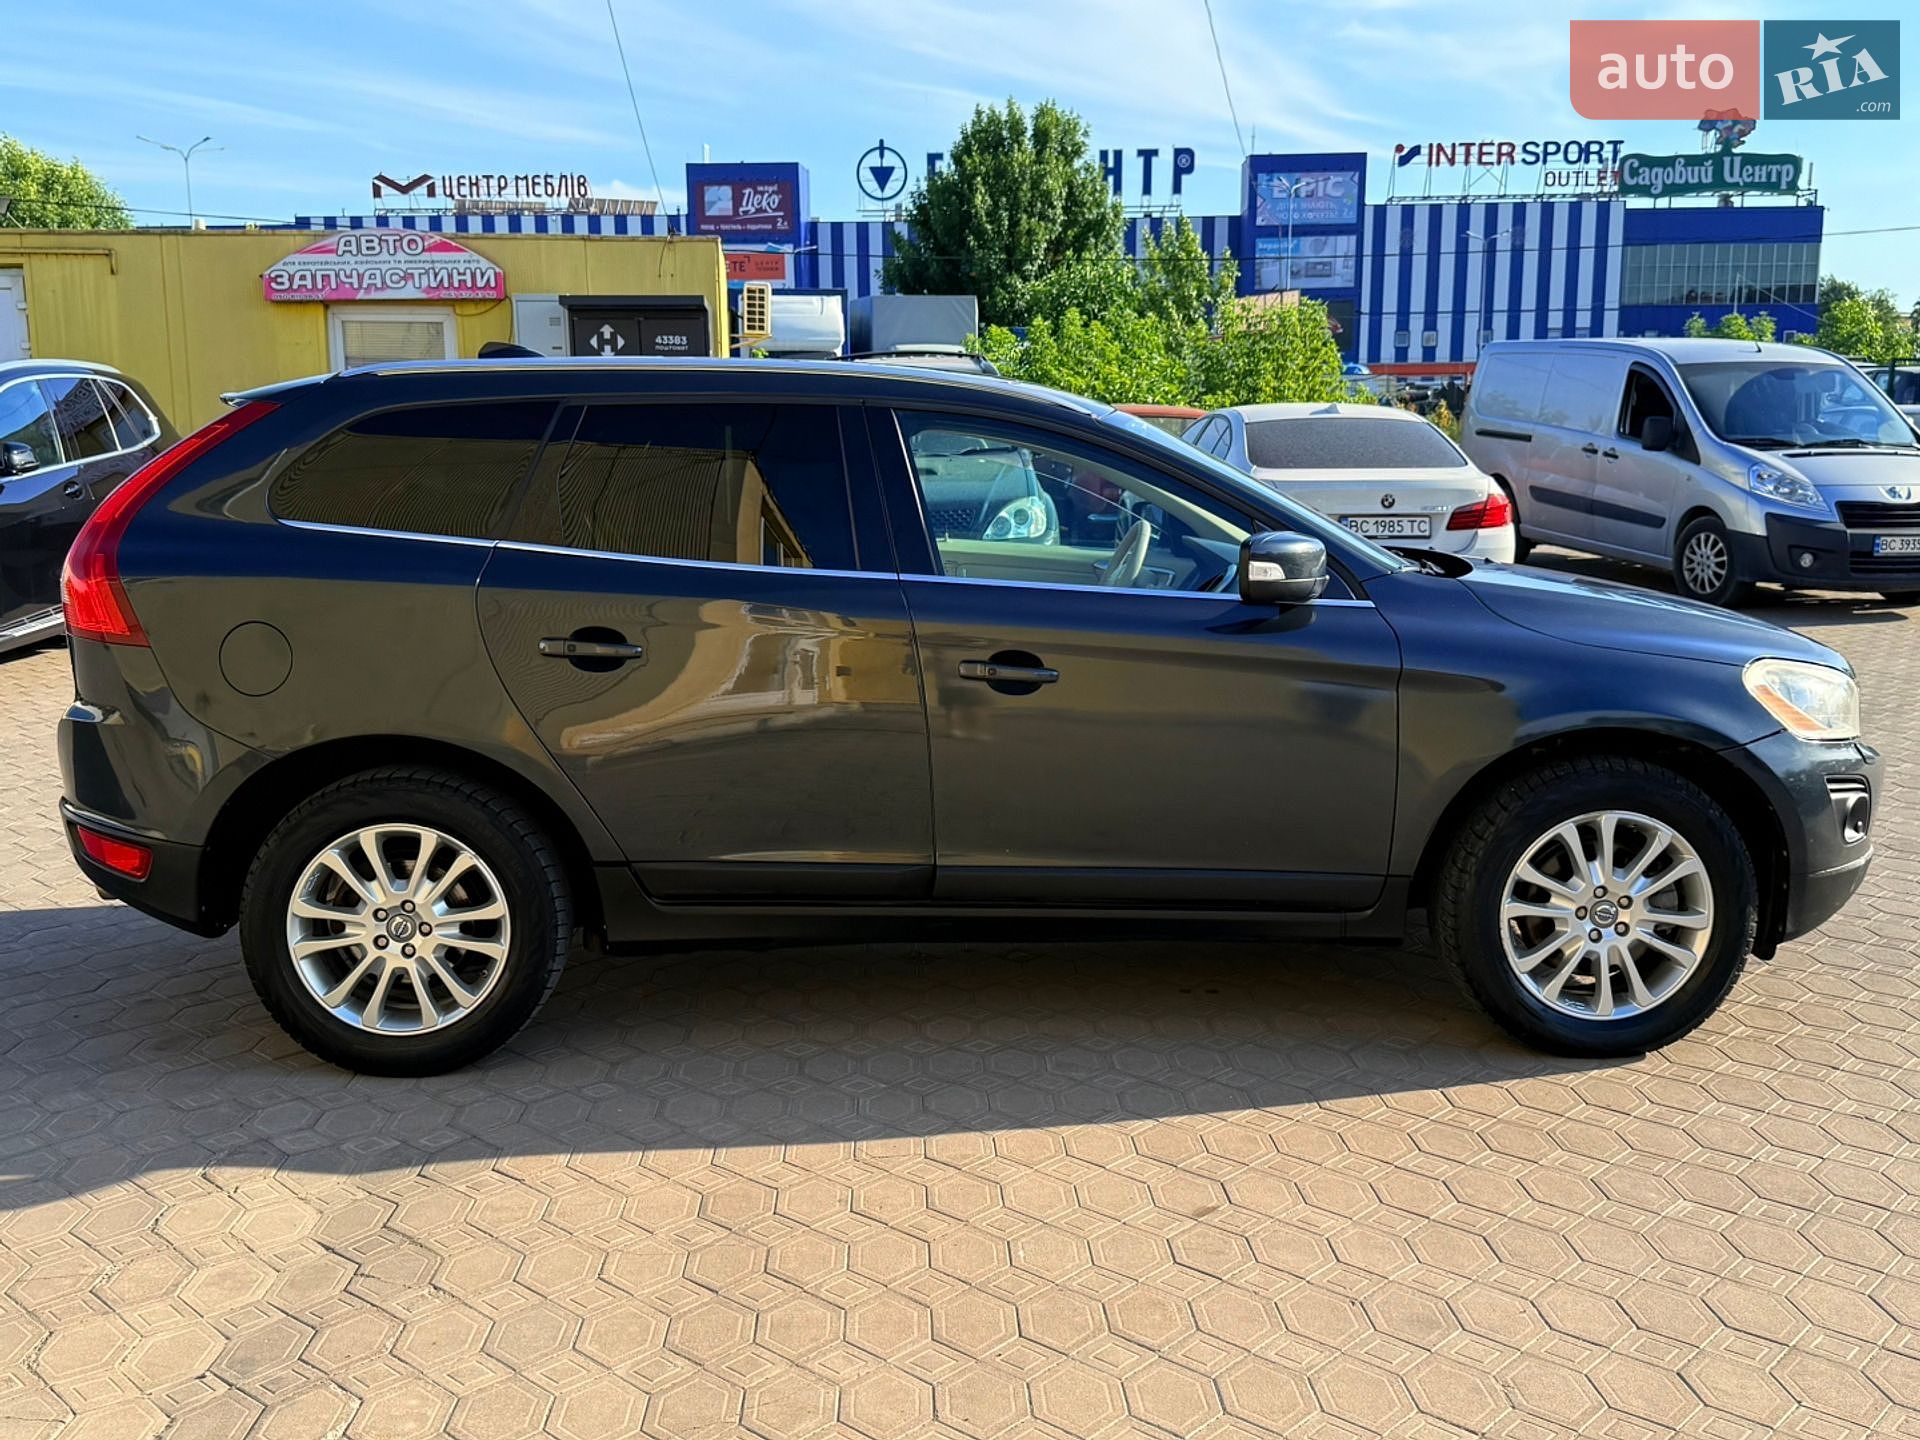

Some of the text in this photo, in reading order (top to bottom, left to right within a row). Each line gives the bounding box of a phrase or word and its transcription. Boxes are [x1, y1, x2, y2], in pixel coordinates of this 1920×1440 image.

[442, 174, 507, 199] ЦЕНТР
[515, 173, 588, 198] МЕБЛІВ
[1622, 156, 1794, 194] Садовий Центр
[739, 187, 779, 216] Деко
[336, 234, 426, 257] АВТО
[268, 267, 498, 291] ЗАПЧАСТИНИ
[655, 335, 688, 346] 43383
[1373, 520, 1404, 533] 1985
